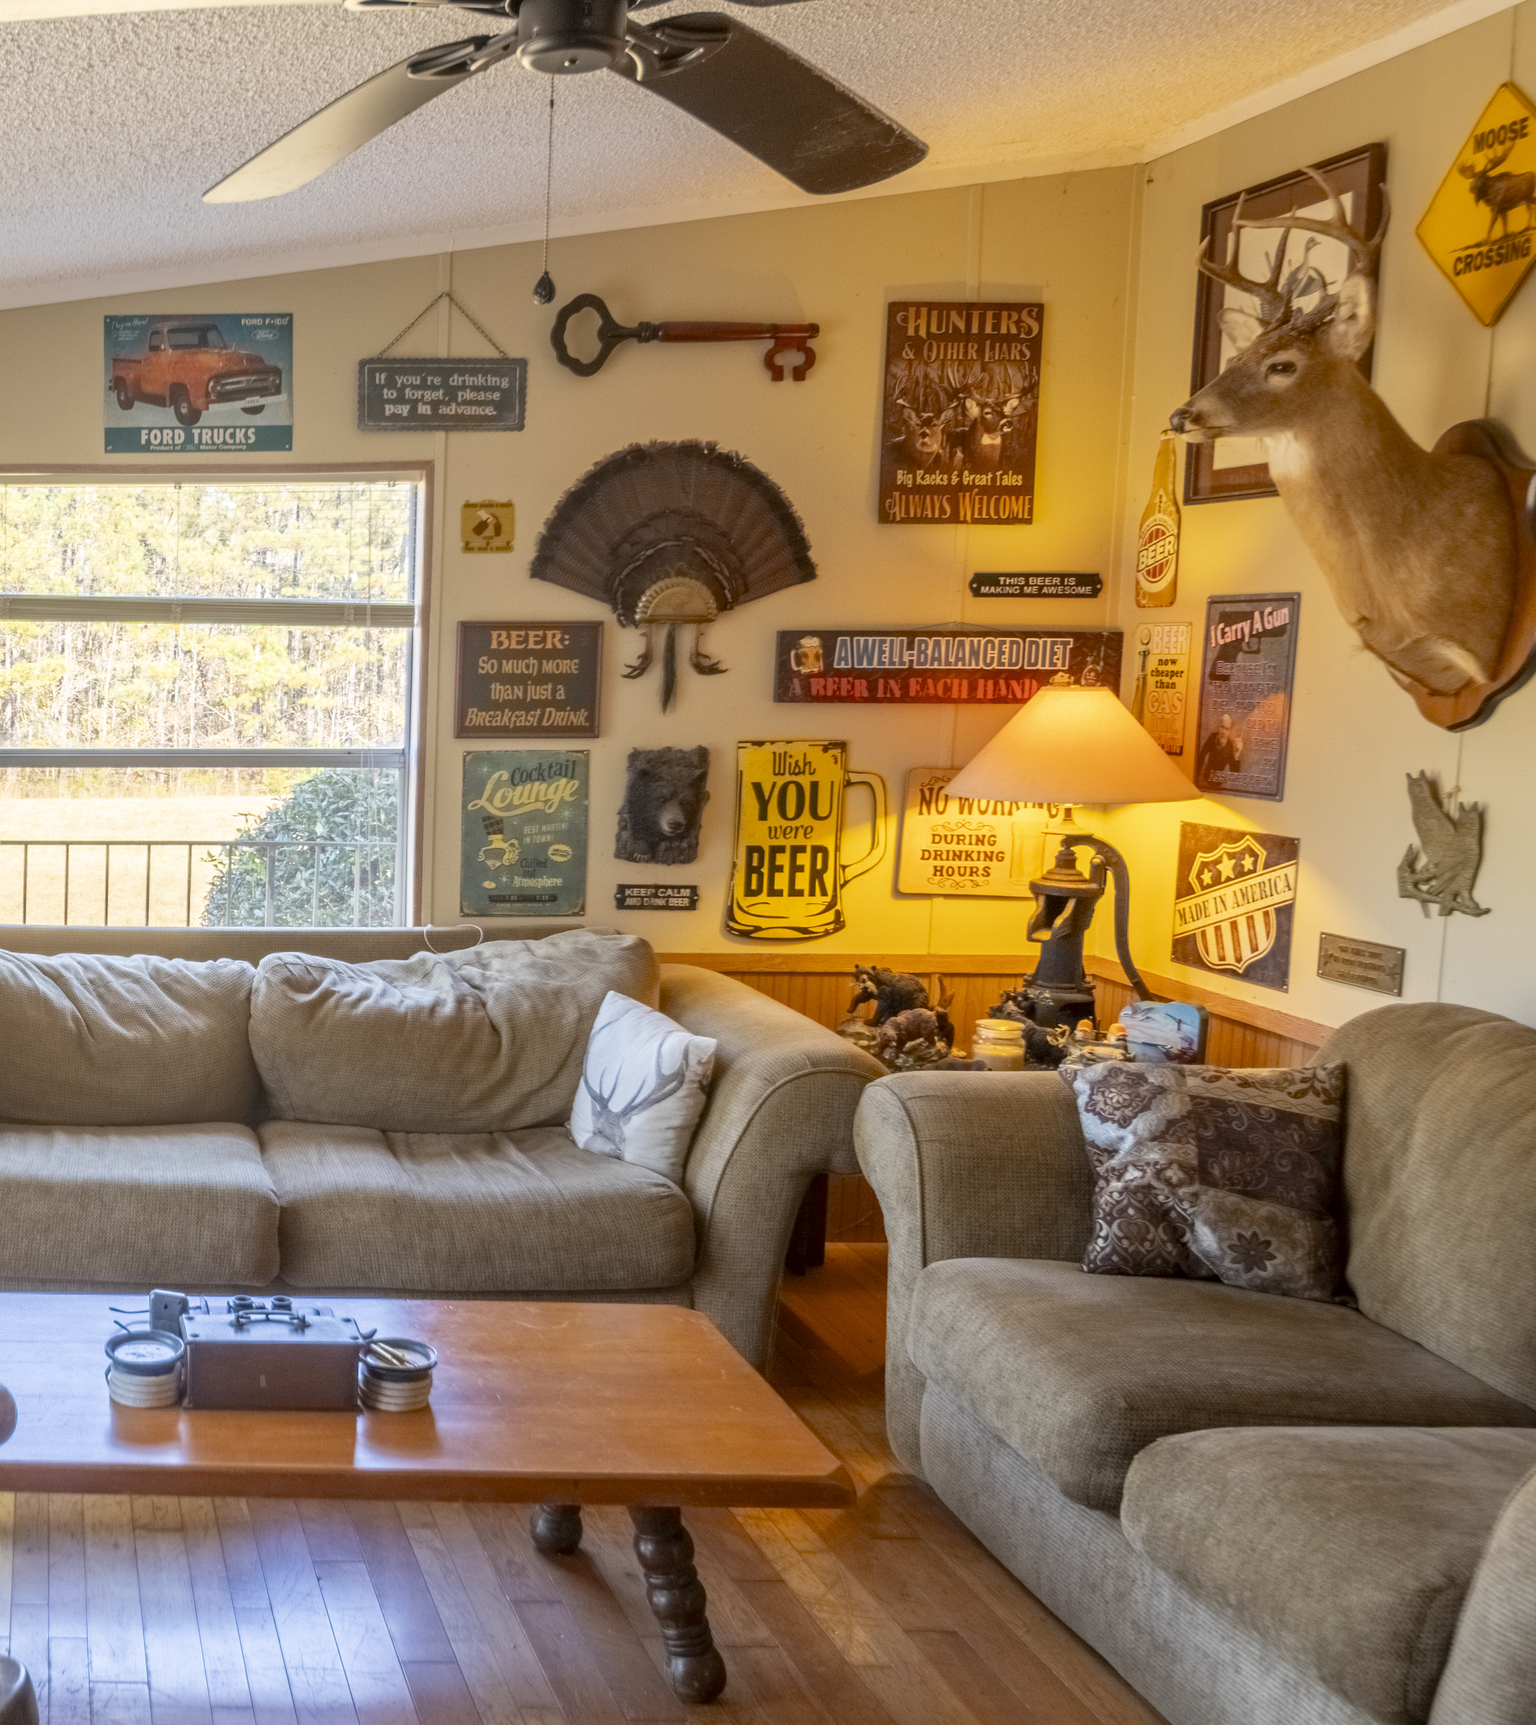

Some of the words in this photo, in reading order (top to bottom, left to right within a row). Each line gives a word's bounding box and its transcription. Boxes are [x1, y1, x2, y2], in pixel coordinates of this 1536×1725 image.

[1473, 116, 1530, 155] MOOSE
[1453, 237, 1532, 277] CROSSING
[241, 318, 263, 326] FORD
[896, 306, 1040, 339] HUNTERS
[901, 341, 915, 360] &
[923, 339, 978, 363] OTHER
[984, 339, 1031, 362] LIARS
[375, 372, 387, 385] If
[395, 373, 442, 387] you're
[449, 373, 509, 389] drinking
[382, 387, 397, 399] to
[404, 387, 450, 401] forget,
[457, 388, 501, 402] please
[384, 403, 411, 416] pay
[417, 402, 432, 415] in
[438, 403, 497, 415] advance.
[141, 428, 185, 445] FORD
[192, 427, 256, 444] TRUCKS
[896, 469, 913, 488] Big
[916, 469, 948, 486] Racks
[950, 471, 960, 485] &
[962, 470, 993, 486] Great
[995, 470, 1023, 486] Tales
[885, 491, 951, 522] ALWAYS
[958, 488, 1033, 524] WELCOME
[1138, 534, 1175, 572] BEER
[980, 586, 1020, 594] MAKING
[1023, 586, 1039, 594] ME
[1041, 586, 1093, 594] AWESOME
[998, 577, 1026, 585] THIS
[1028, 577, 1061, 586] BEER
[1064, 577, 1076, 586] IS
[1210, 624, 1216, 648] I
[1216, 620, 1251, 645] Carry
[1252, 610, 1263, 635] A
[1263, 606, 1290, 630] Gun
[490, 630, 570, 650] BEER:
[1152, 625, 1187, 655] BEER
[833, 637, 851, 669] A
[853, 637, 1024, 670] WELL-BALANCED
[1024, 638, 1073, 670] DIET
[1157, 658, 1179, 666] now
[1150, 667, 1184, 679] cheaper
[526, 680, 552, 703] just
[555, 685, 566, 700] a
[789, 677, 802, 696] A
[809, 677, 869, 697] BEER
[876, 678, 902, 698] IN
[908, 678, 969, 699] EACH
[976, 678, 1038, 699] HAND
[1155, 679, 1177, 689] than
[1146, 690, 1183, 715] GAS
[465, 707, 541, 729] Breakfast
[541, 707, 590, 727] Drink.
[510, 759, 577, 787] Cocktail
[772, 751, 816, 776] Wish
[467, 770, 580, 817] Lounge
[751, 780, 834, 822] YOU
[918, 786, 949, 816] NO
[523, 824, 540, 835] BEST
[541, 822, 569, 832] MARTINI
[767, 824, 814, 840] were
[523, 837, 531, 845] IN
[931, 834, 997, 846] DURING
[520, 858, 548, 869] Chilled
[920, 849, 1005, 862] DRINKING
[522, 868, 537, 878] out
[743, 844, 829, 897] BEER
[932, 865, 991, 878] HOURS
[512, 875, 563, 888] Atmosphere
[624, 897, 642, 906] AND
[643, 897, 668, 906] DRINK
[668, 898, 690, 907] BEER
[625, 888, 655, 896] KEEP
[657, 888, 691, 897] CALM
[1176, 900, 1212, 927] MADE
[1212, 895, 1228, 915] IN
[1231, 873, 1293, 910] AMERICA
